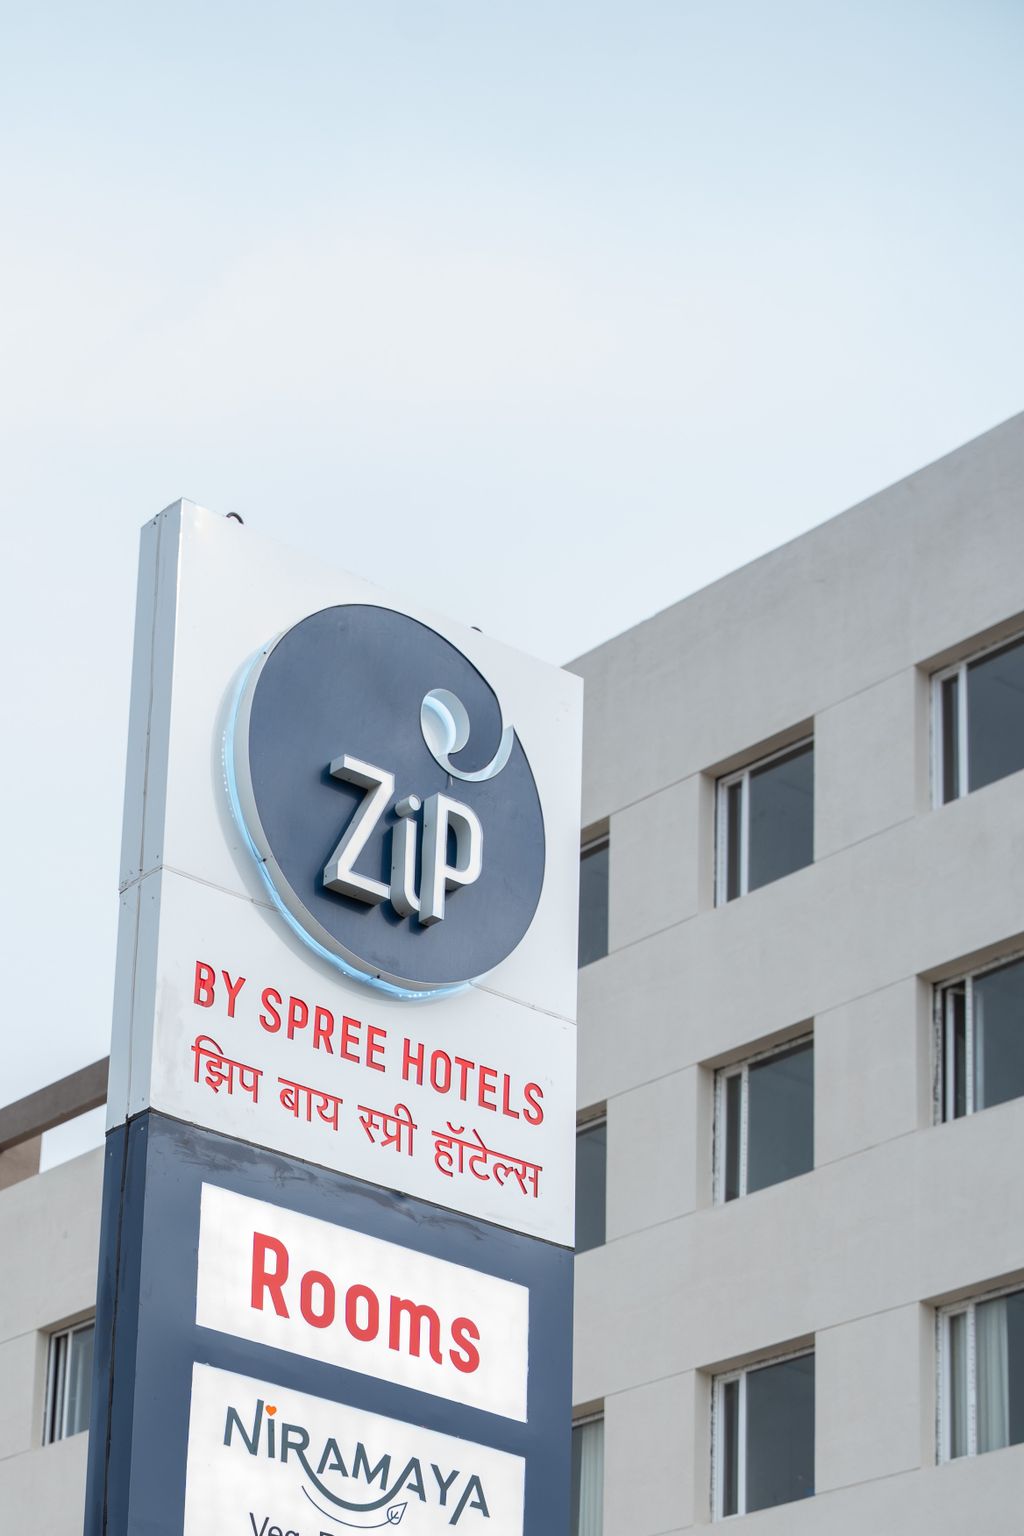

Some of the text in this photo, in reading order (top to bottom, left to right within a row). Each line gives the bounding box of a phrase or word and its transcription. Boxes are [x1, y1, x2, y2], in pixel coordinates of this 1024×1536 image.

[191, 1034, 543, 1199] झिप बाय स्प्री हॉटेल्स
[193, 960, 545, 1126] BY SPREE HOTELS
[250, 1231, 480, 1374] Rooms
